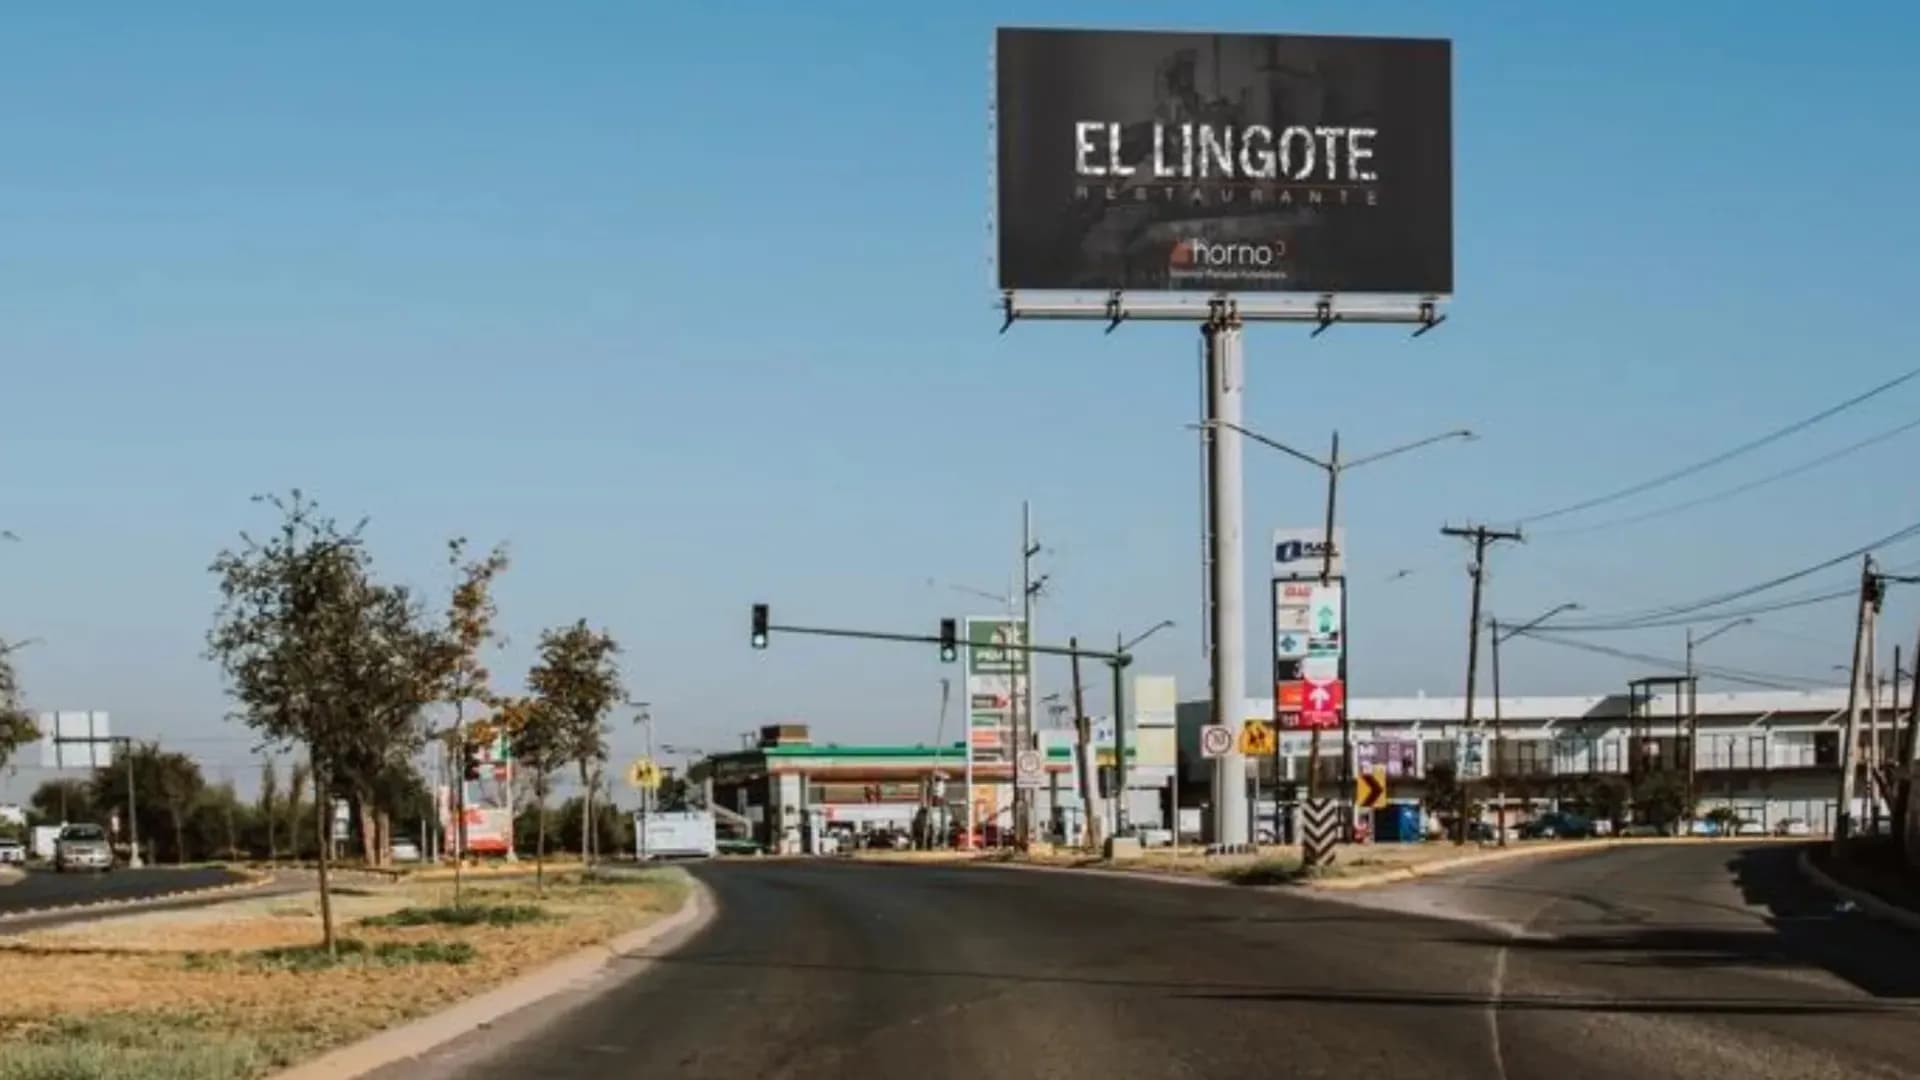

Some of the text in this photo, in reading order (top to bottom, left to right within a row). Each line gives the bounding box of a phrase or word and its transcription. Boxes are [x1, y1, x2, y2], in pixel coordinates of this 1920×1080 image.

[1075, 121, 1378, 180] EL LINGOTE
[1076, 186, 1378, 206] RESTAURANTE
